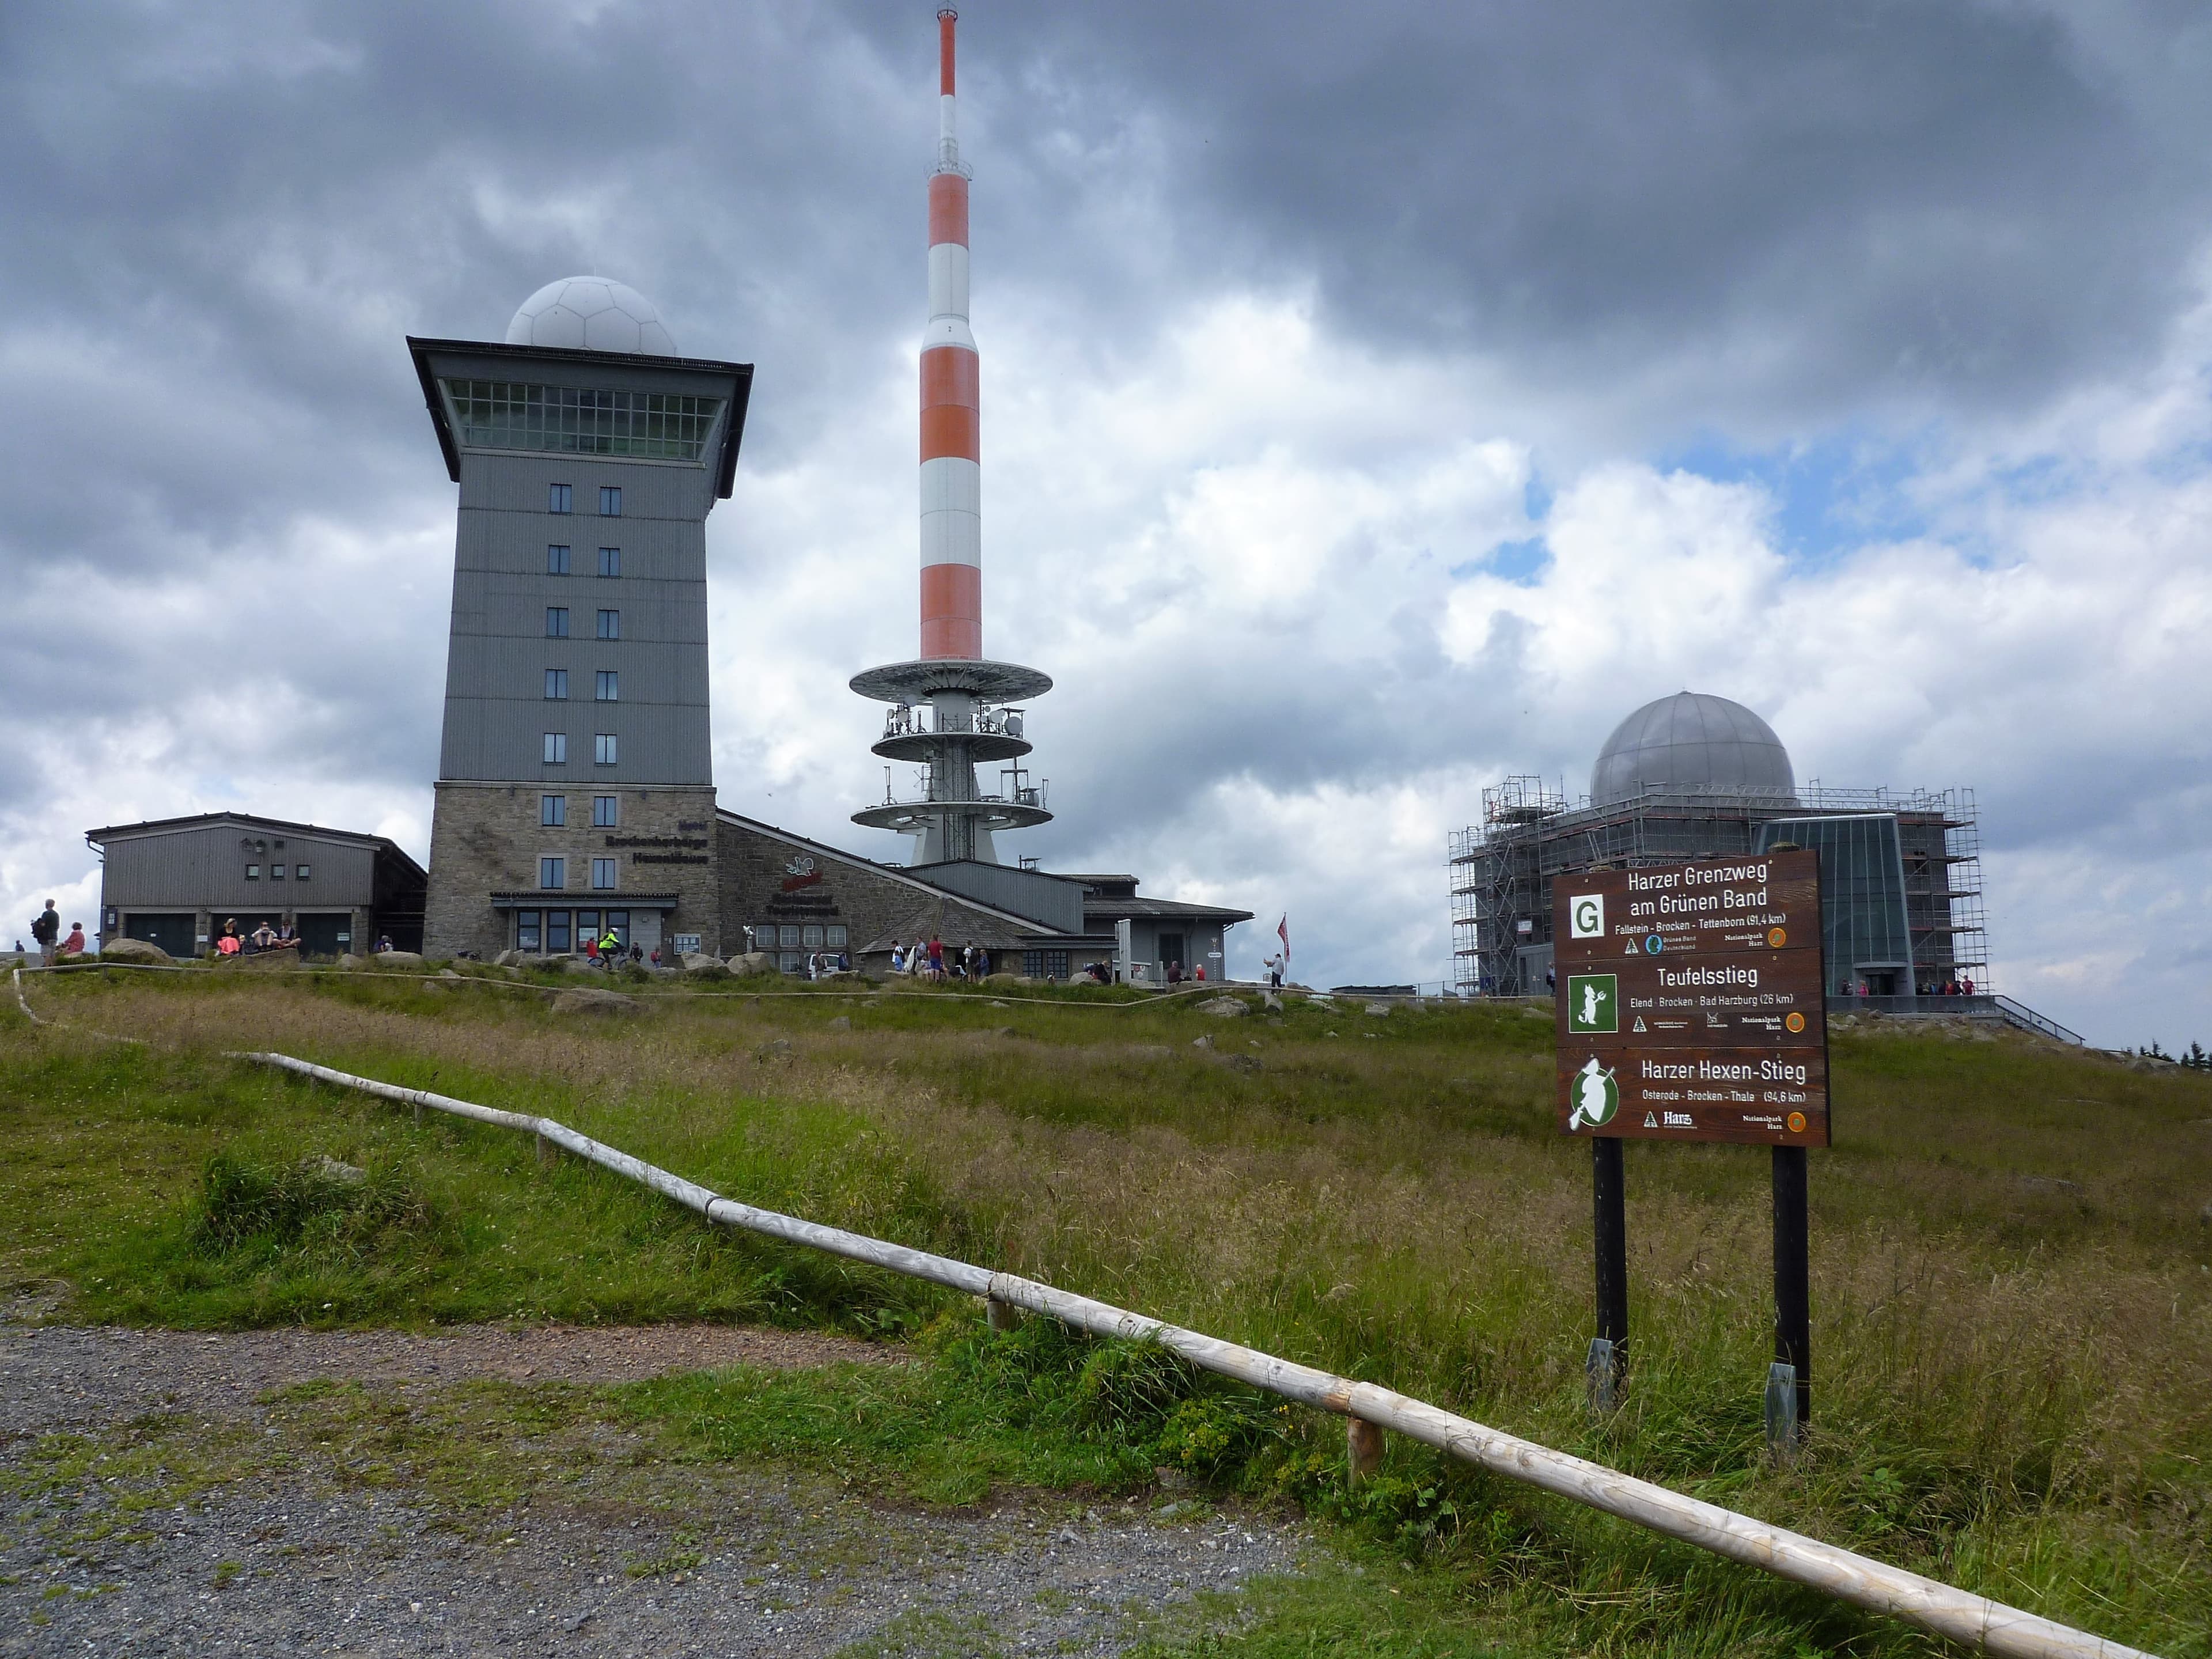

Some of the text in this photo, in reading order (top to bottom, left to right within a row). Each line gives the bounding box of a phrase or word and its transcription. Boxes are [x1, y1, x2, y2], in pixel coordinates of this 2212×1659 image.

[1628, 863, 1767, 891] Harzer Grenzweg
[1631, 887, 1767, 916] am Grünen Band
[1576, 901, 1599, 933] G
[1615, 922, 1649, 935] Fallstein
[1656, 921, 1690, 932] Brocken
[1699, 918, 1745, 930] Tettenborn
[1768, 913, 1786, 925] km)
[1725, 933, 1763, 942] Nationalpark
[1657, 965, 1758, 987] Teufelsstieg
[1630, 997, 1653, 1008] Elend
[1659, 997, 1692, 1007] Brocken
[1700, 995, 1716, 1006] Bad
[1718, 995, 1758, 1007] Harzburg
[1760, 994, 1774, 1005] (26
[1776, 993, 1793, 1005] km)
[1741, 1016, 1781, 1024] Nationalpark
[1642, 1060, 1805, 1085] Harzer Hexen-Stieg
[1643, 1089, 1679, 1100] Osterode
[1687, 1090, 1722, 1101] Brocken
[1730, 1091, 1755, 1102] Thale
[1764, 1091, 1786, 1103] (94,6
[1788, 1091, 1806, 1103] km)
[1664, 1111, 1692, 1125] Harz
